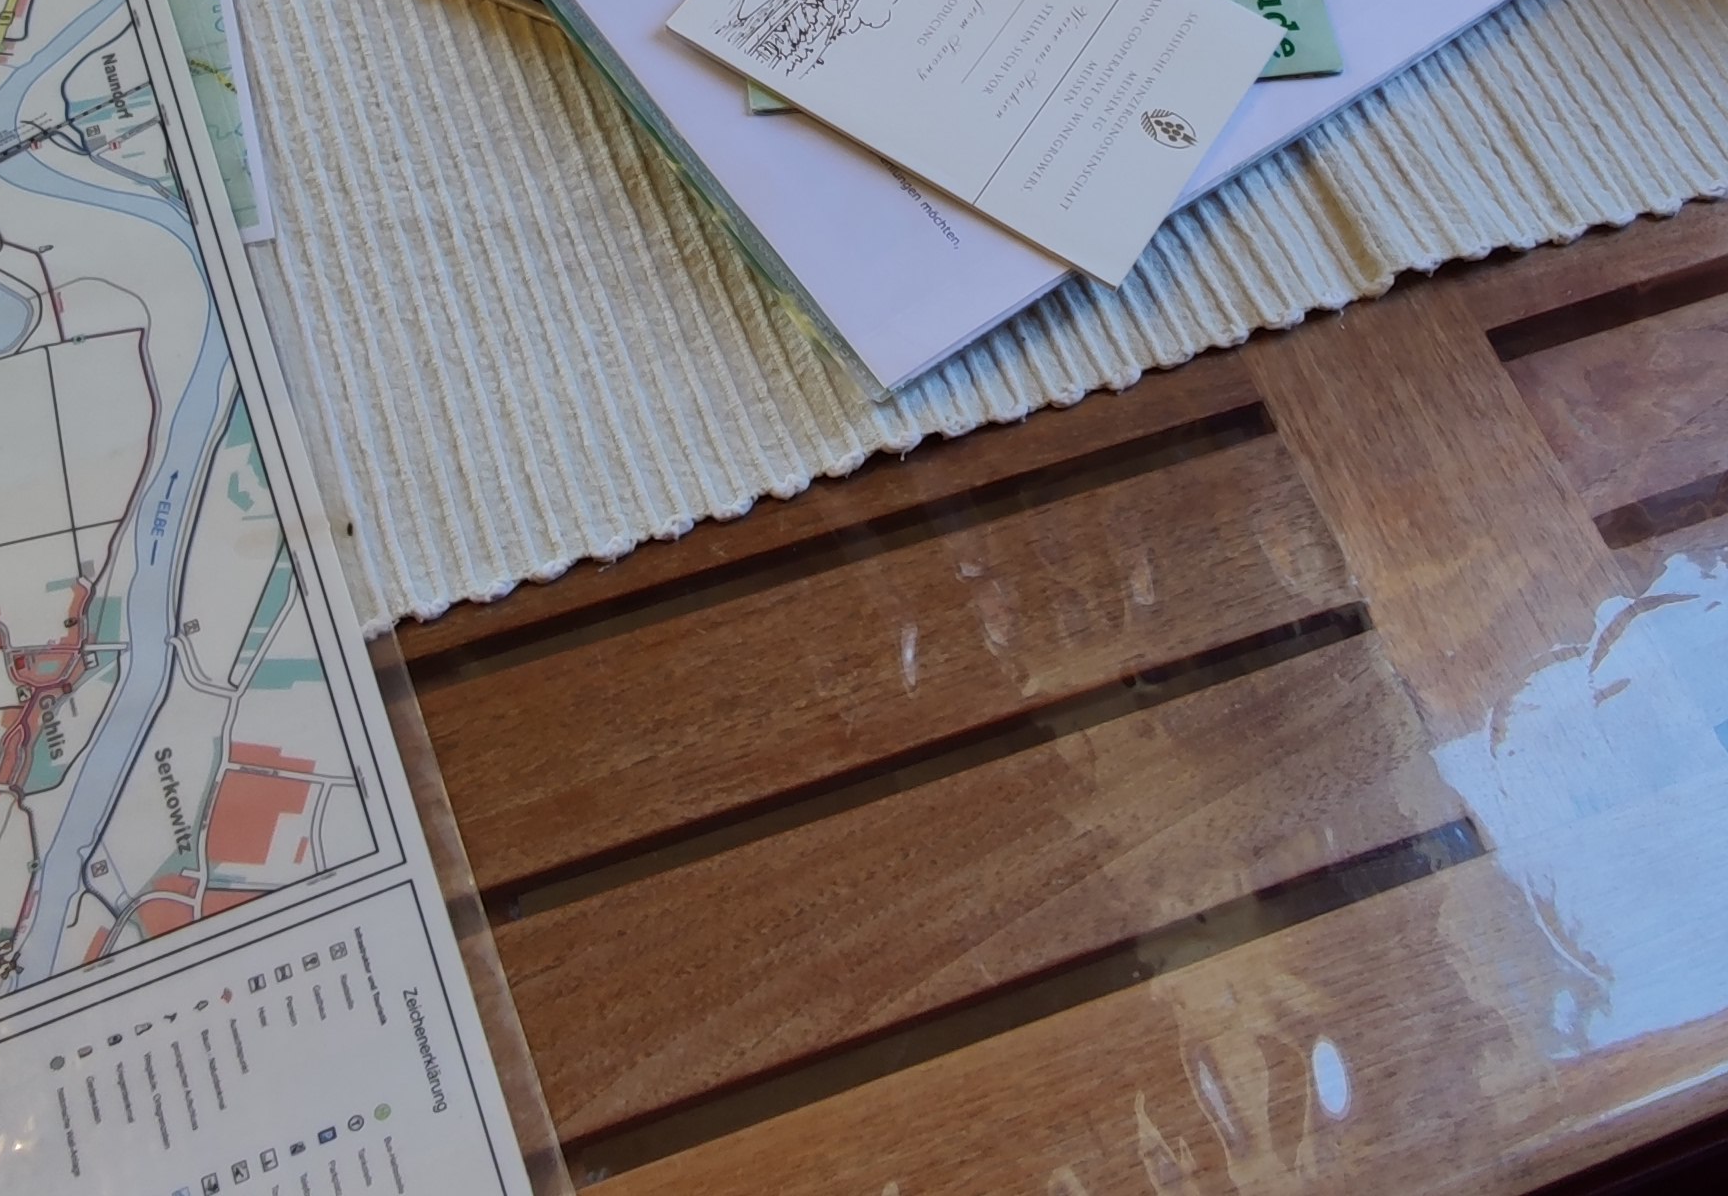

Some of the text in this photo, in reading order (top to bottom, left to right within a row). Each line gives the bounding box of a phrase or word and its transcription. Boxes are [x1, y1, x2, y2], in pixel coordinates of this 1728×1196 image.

[980, 1, 1056, 97] STELLEN SICH VOR
[1048, 3, 1090, 45] Weine
[100, 51, 135, 122] Naundorf
[911, 33, 966, 85] Saxony
[1061, 58, 1098, 106] MEISSEN
[1088, 23, 1144, 96] COOPERATIVE
[992, 67, 1042, 122] Sachsen
[1077, 94, 1095, 111] OF
[1101, 69, 1139, 116] MEISSEN
[1057, 73, 1156, 212] WINZERGENOSSENSCHAFT
[918, 200, 966, 252] möchten,
[149, 500, 171, 539] ELBE
[36, 692, 69, 762] Gohlis
[152, 745, 195, 856] Serkowitz
[401, 986, 451, 1115] Zeichenerklärung
